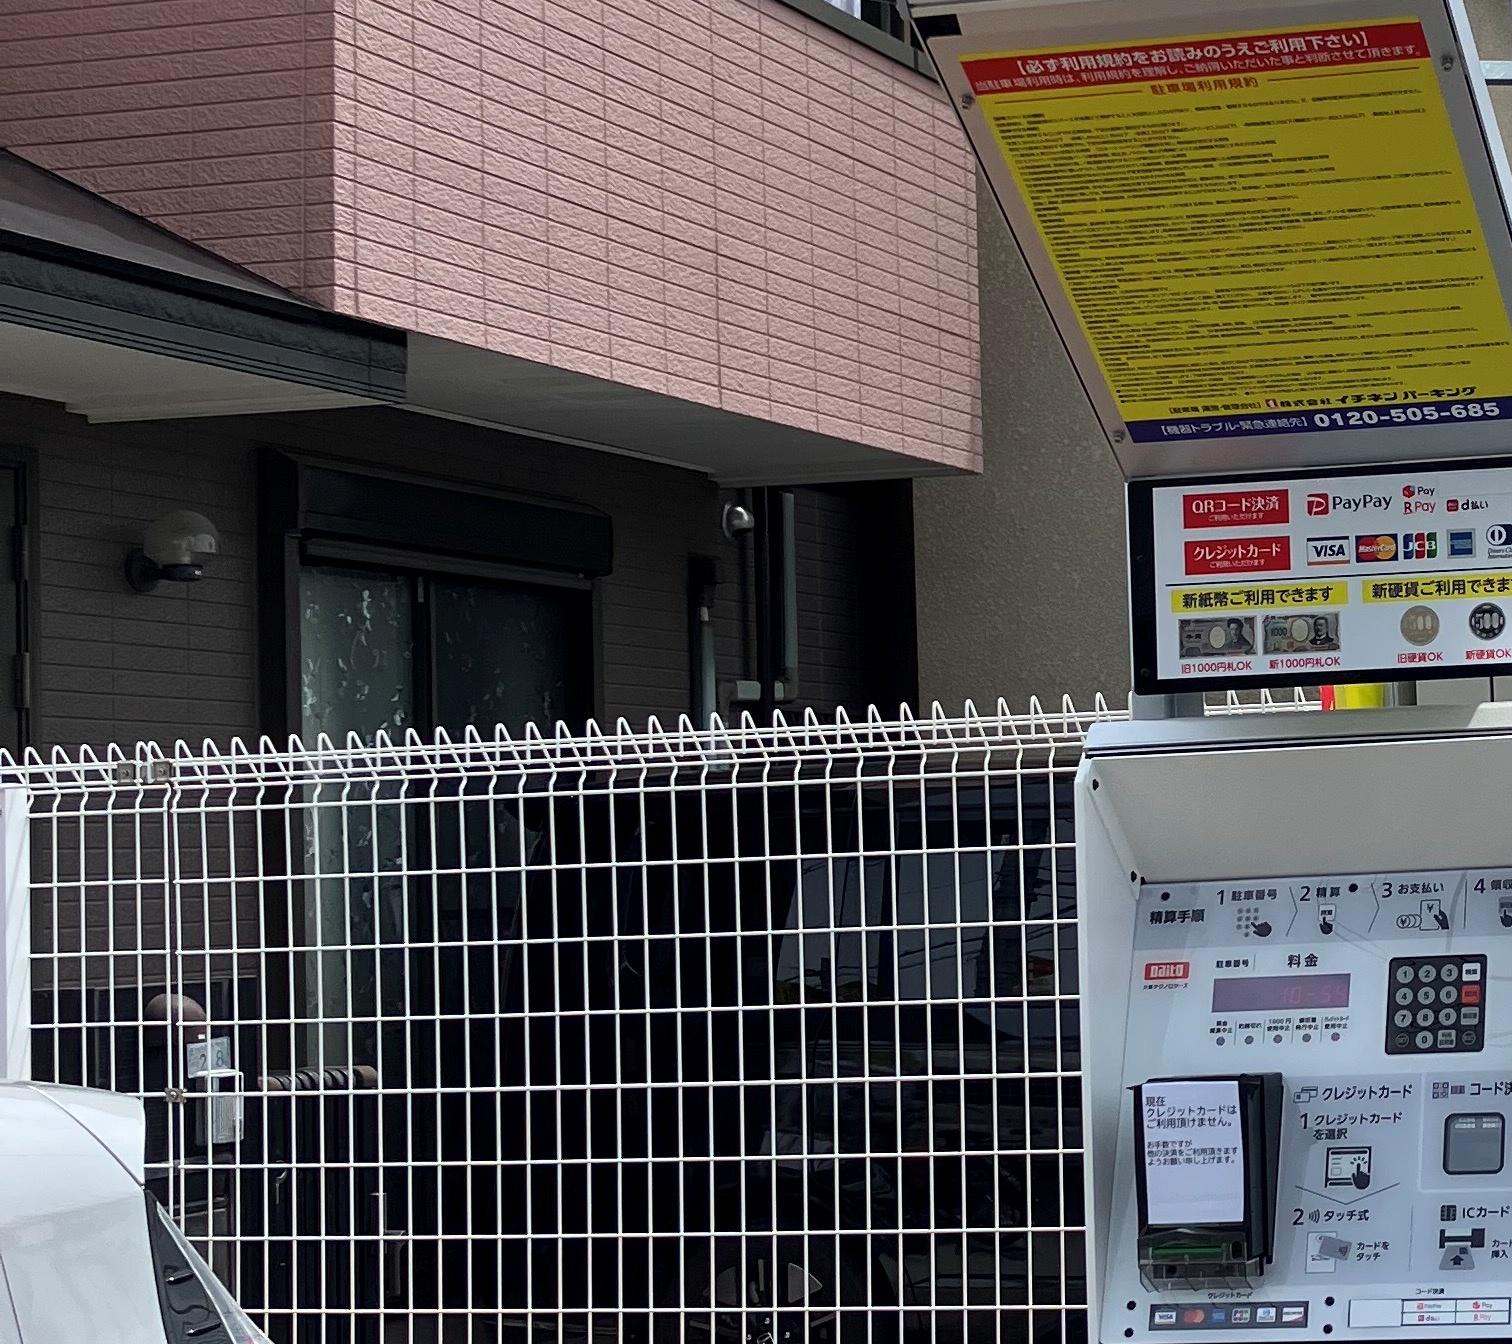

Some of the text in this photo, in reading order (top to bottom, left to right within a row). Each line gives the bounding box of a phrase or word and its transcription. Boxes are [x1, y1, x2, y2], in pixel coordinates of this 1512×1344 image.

[1336, 391, 1398, 405] イチネン
[1403, 385, 1477, 400] パーキング
[1313, 401, 1501, 428] 0120-505-685
[1417, 486, 1436, 497] Pay
[1191, 495, 1280, 514] QRコード決済
[1332, 494, 1393, 512] PayPay
[1415, 501, 1436, 513] Pay
[1193, 542, 1281, 561] クレジットカード
[1312, 543, 1346, 558] VISA
[1403, 540, 1437, 552] JCB
[1182, 585, 1334, 609] 新紙幣ご利用できます
[1397, 652, 1444, 664] 旧硬貨OK
[1465, 648, 1512, 660] 新硬貨OK
[1181, 661, 1252, 675] 旧1000円札OK
[1268, 657, 1341, 670] 新1000円札OK
[1299, 885, 1311, 902] 2
[1381, 882, 1445, 898] 3 お支払い
[1474, 878, 1486, 894] 4
[1217, 888, 1278, 905] 1 駐車番号
[1149, 908, 1206, 925] 精算手順
[1287, 953, 1319, 969] 料金
[1322, 1084, 1413, 1102] クレジットカード
[1145, 1096, 1167, 1107] 現在
[1146, 1105, 1237, 1118] クレジットカードは
[1146, 1116, 1232, 1129] ご利用頂けません。
[1300, 1112, 1403, 1129] 1 クレジットカード
[1312, 1128, 1348, 1141] を選択
[1292, 1208, 1370, 1226] 2 タッチ式
[1462, 1205, 1511, 1219] ICカード
[1356, 1241, 1390, 1251] カードを
[1356, 1252, 1381, 1262] タッチ
